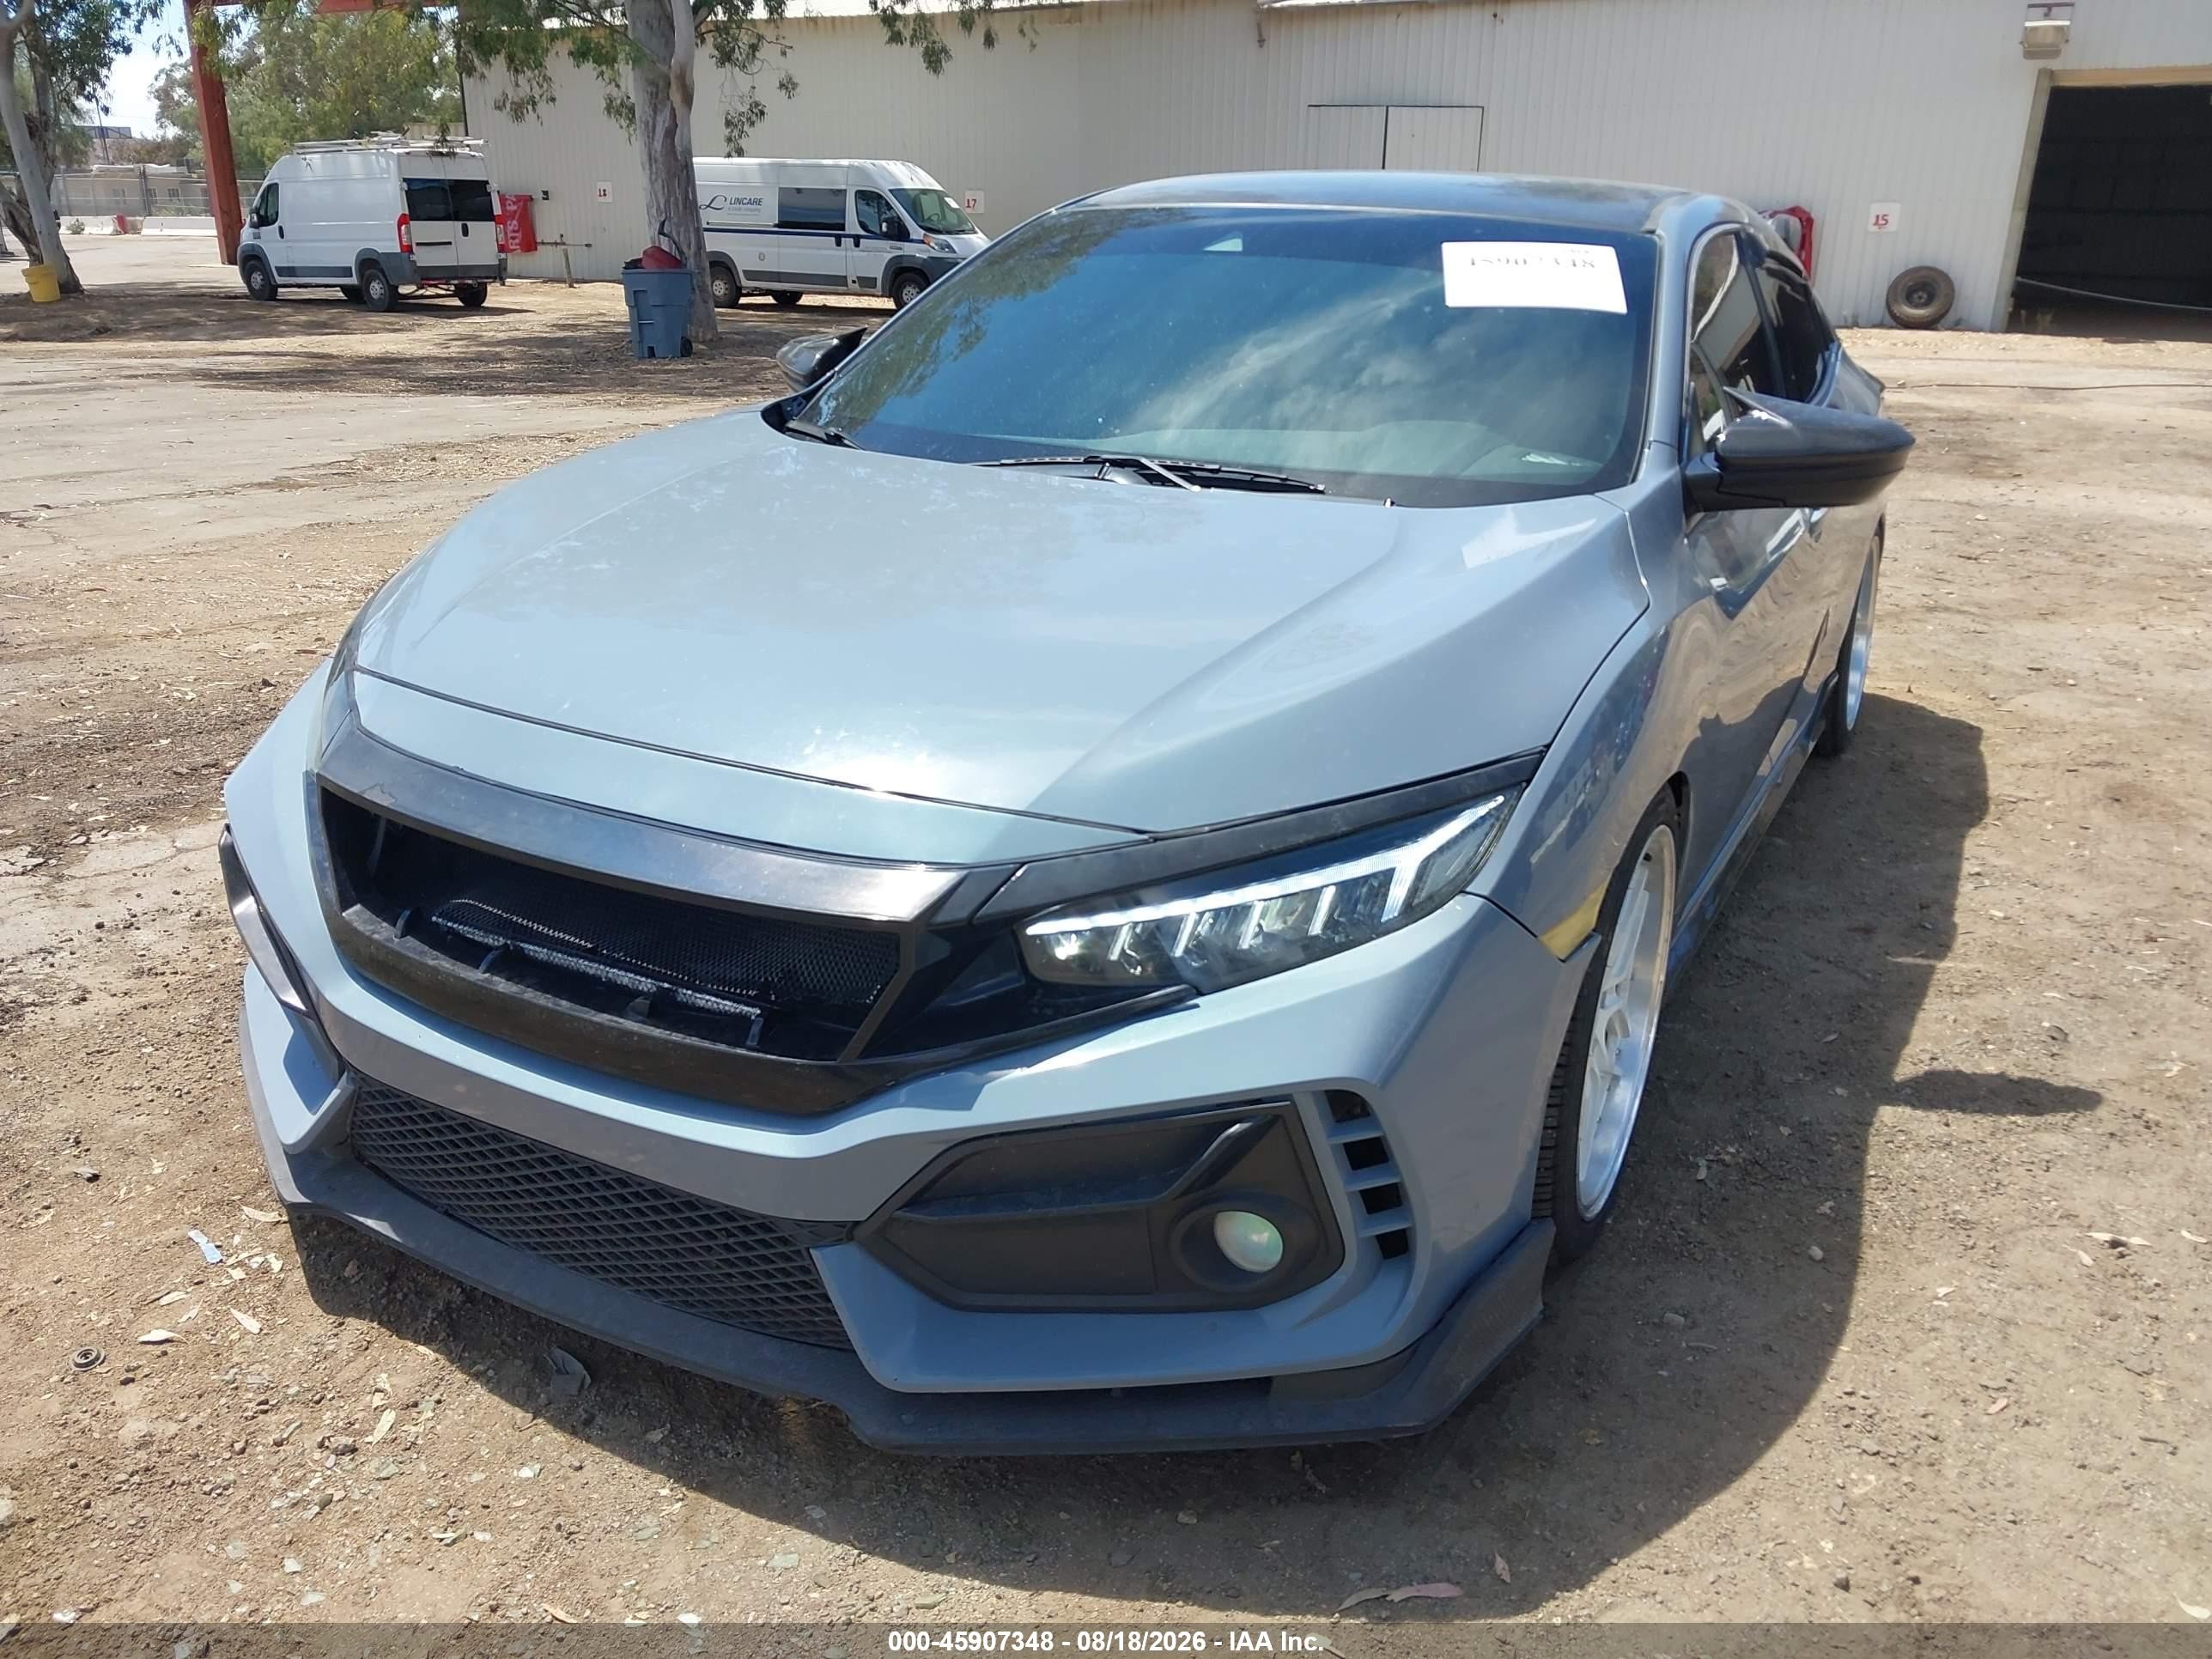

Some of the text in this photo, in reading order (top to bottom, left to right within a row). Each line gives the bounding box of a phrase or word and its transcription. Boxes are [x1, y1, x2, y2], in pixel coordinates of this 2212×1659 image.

[729, 197, 763, 206] LINCARE
[966, 198, 977, 209] 17
[1873, 214, 1889, 227] 15
[507, 220, 522, 253] RTS
